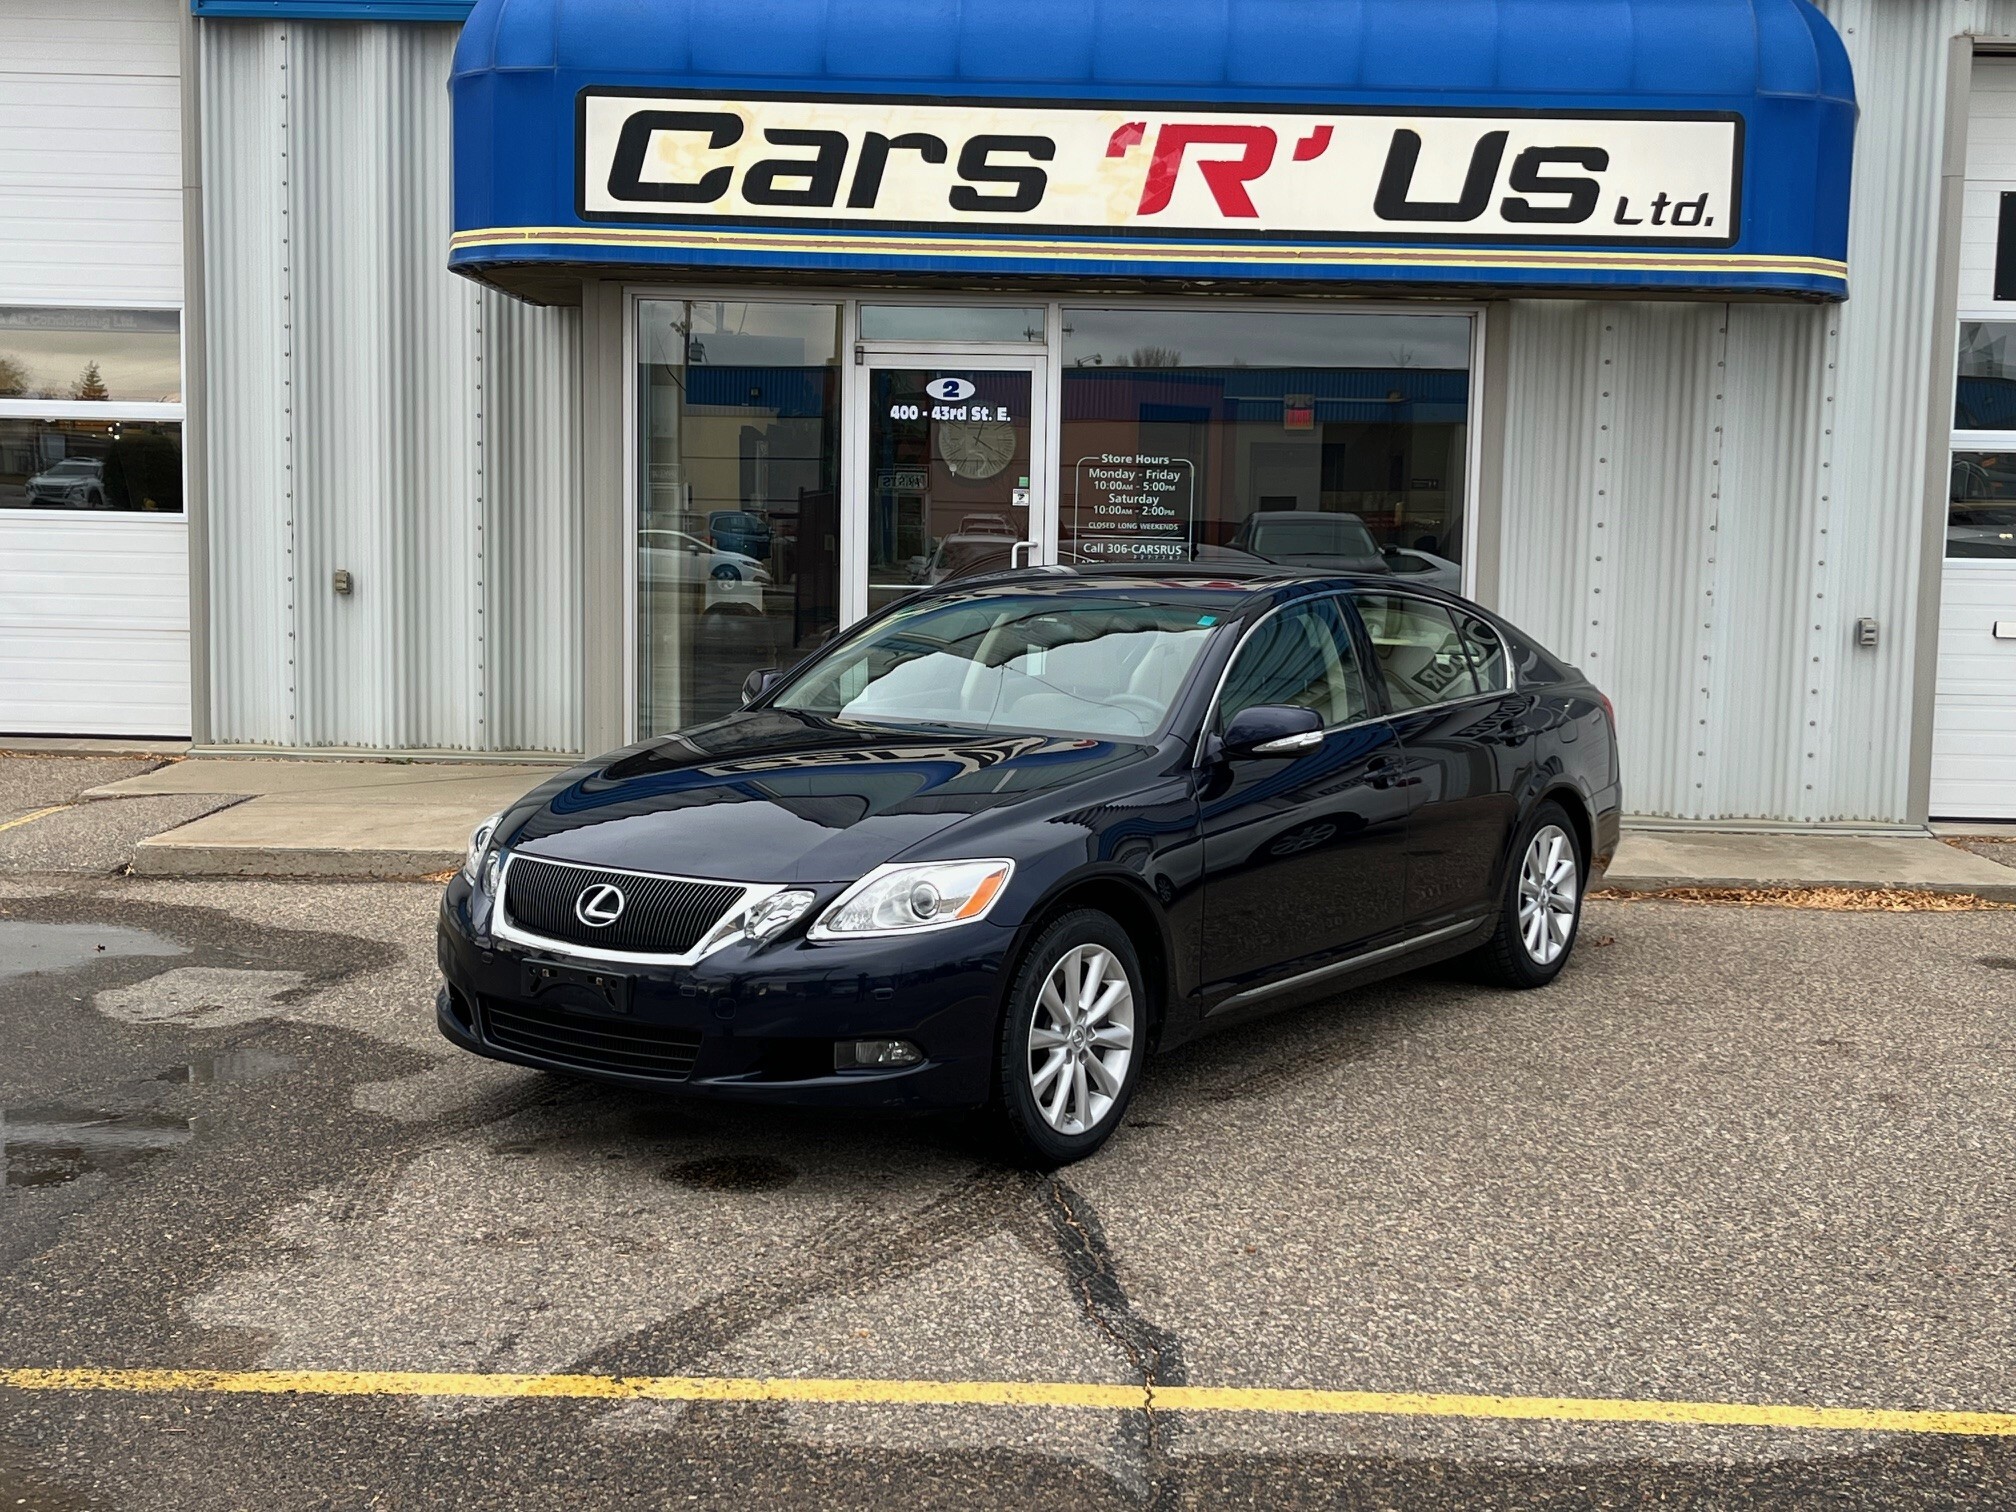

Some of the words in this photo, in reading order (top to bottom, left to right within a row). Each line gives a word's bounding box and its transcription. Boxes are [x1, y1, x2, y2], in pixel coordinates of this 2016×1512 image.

[607, 109, 1057, 213] Cars
[1373, 128, 1610, 225] Us
[1613, 192, 1714, 227] Ltd.
[943, 380, 960, 398] 2
[890, 405, 918, 420] 400
[932, 406, 966, 421] 43rd
[970, 406, 992, 422] St.
[997, 407, 1011, 422] E.
[1102, 454, 1132, 464] Store
[1136, 454, 1170, 465] Hours
[1089, 469, 1135, 481] Monday
[1146, 470, 1180, 482] Friday
[1108, 494, 1160, 506] Saturday
[1084, 543, 1104, 553] Call
[1106, 544, 1182, 555] 306-CARSRUS
